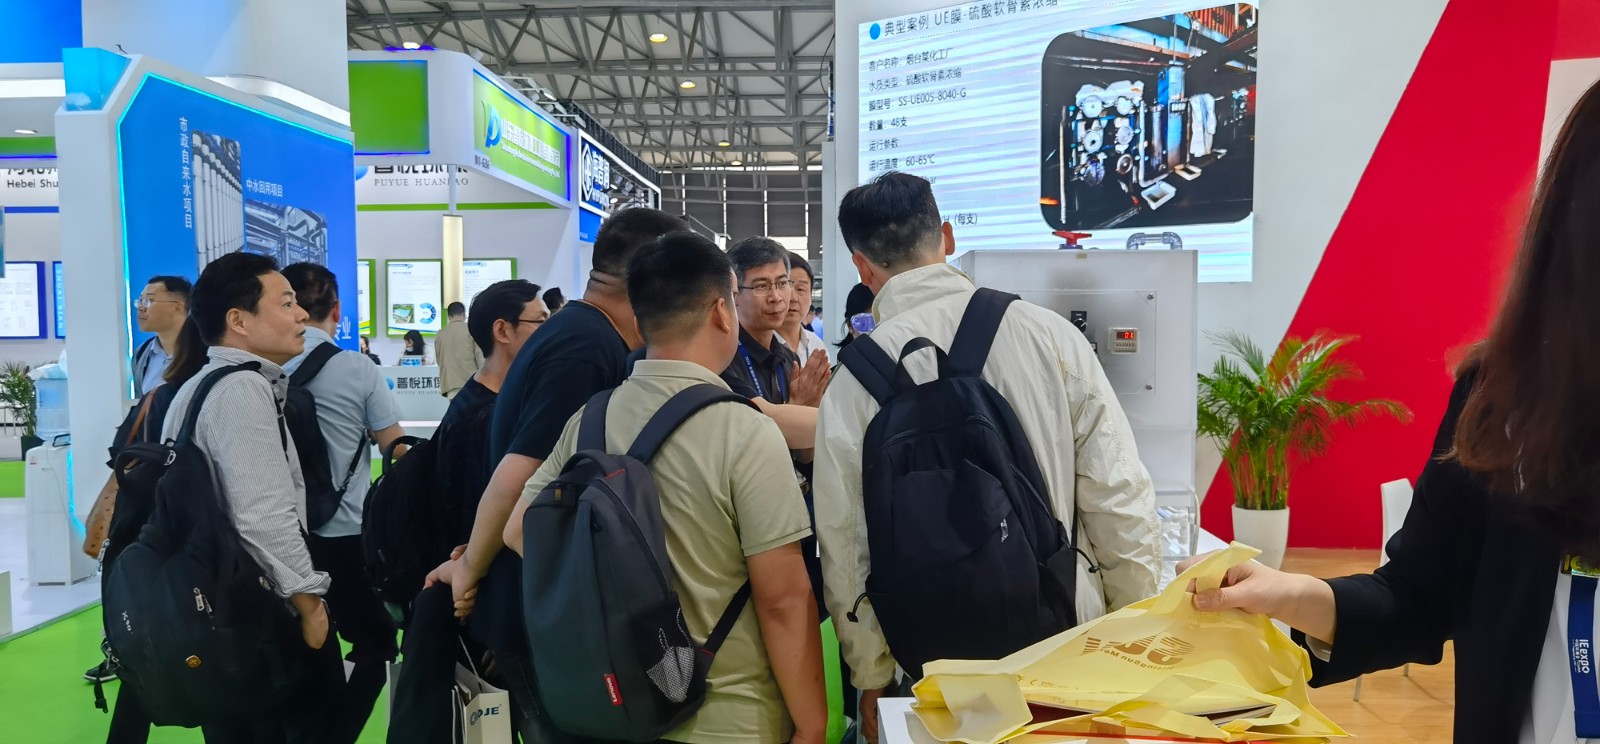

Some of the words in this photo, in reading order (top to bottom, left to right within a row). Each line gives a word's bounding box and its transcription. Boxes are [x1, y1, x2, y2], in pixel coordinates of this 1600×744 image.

[884, 14, 929, 37] 典型案例
[179, 116, 193, 229] 市政自来水项目
[374, 178, 410, 187] PUYUE
[415, 177, 469, 187] HUANAO
[7, 179, 36, 189] Hebei
[245, 178, 283, 198] 中水回用项目
[606, 677, 618, 702] Lenovo
